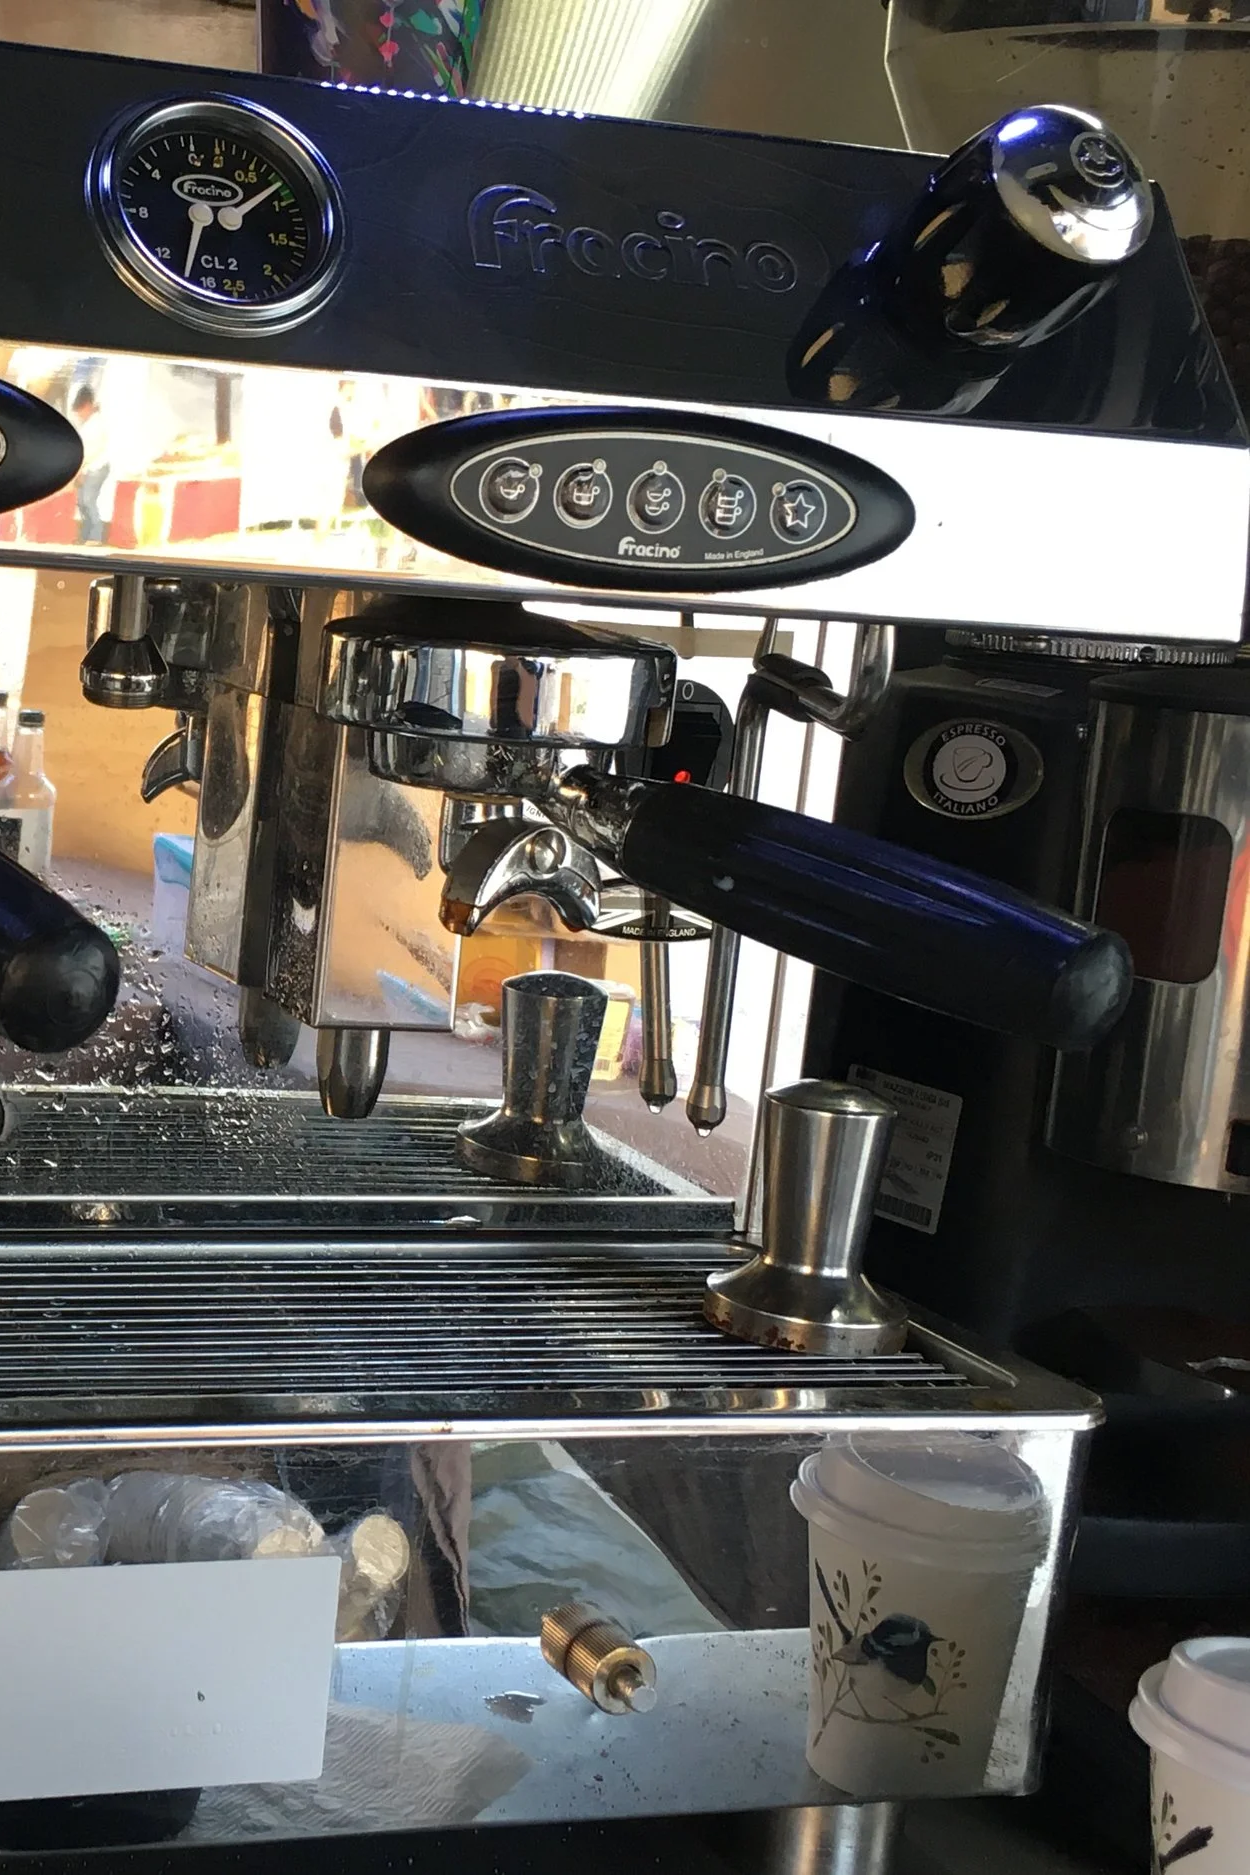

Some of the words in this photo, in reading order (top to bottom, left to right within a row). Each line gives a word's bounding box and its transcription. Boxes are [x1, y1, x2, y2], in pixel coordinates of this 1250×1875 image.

[151, 170, 161, 181] 4
[139, 206, 149, 218] 8
[155, 247, 171, 260] 12
[201, 256, 225, 270] CL
[228, 258, 239, 271] 2
[263, 264, 272, 276] 2
[200, 277, 216, 289] 16
[704, 552, 725, 560] Made
[735, 548, 764, 559] England
[941, 723, 1006, 746] ESPRESSO
[933, 791, 999, 814] ITALIANO
[622, 926, 645, 936] MADE
